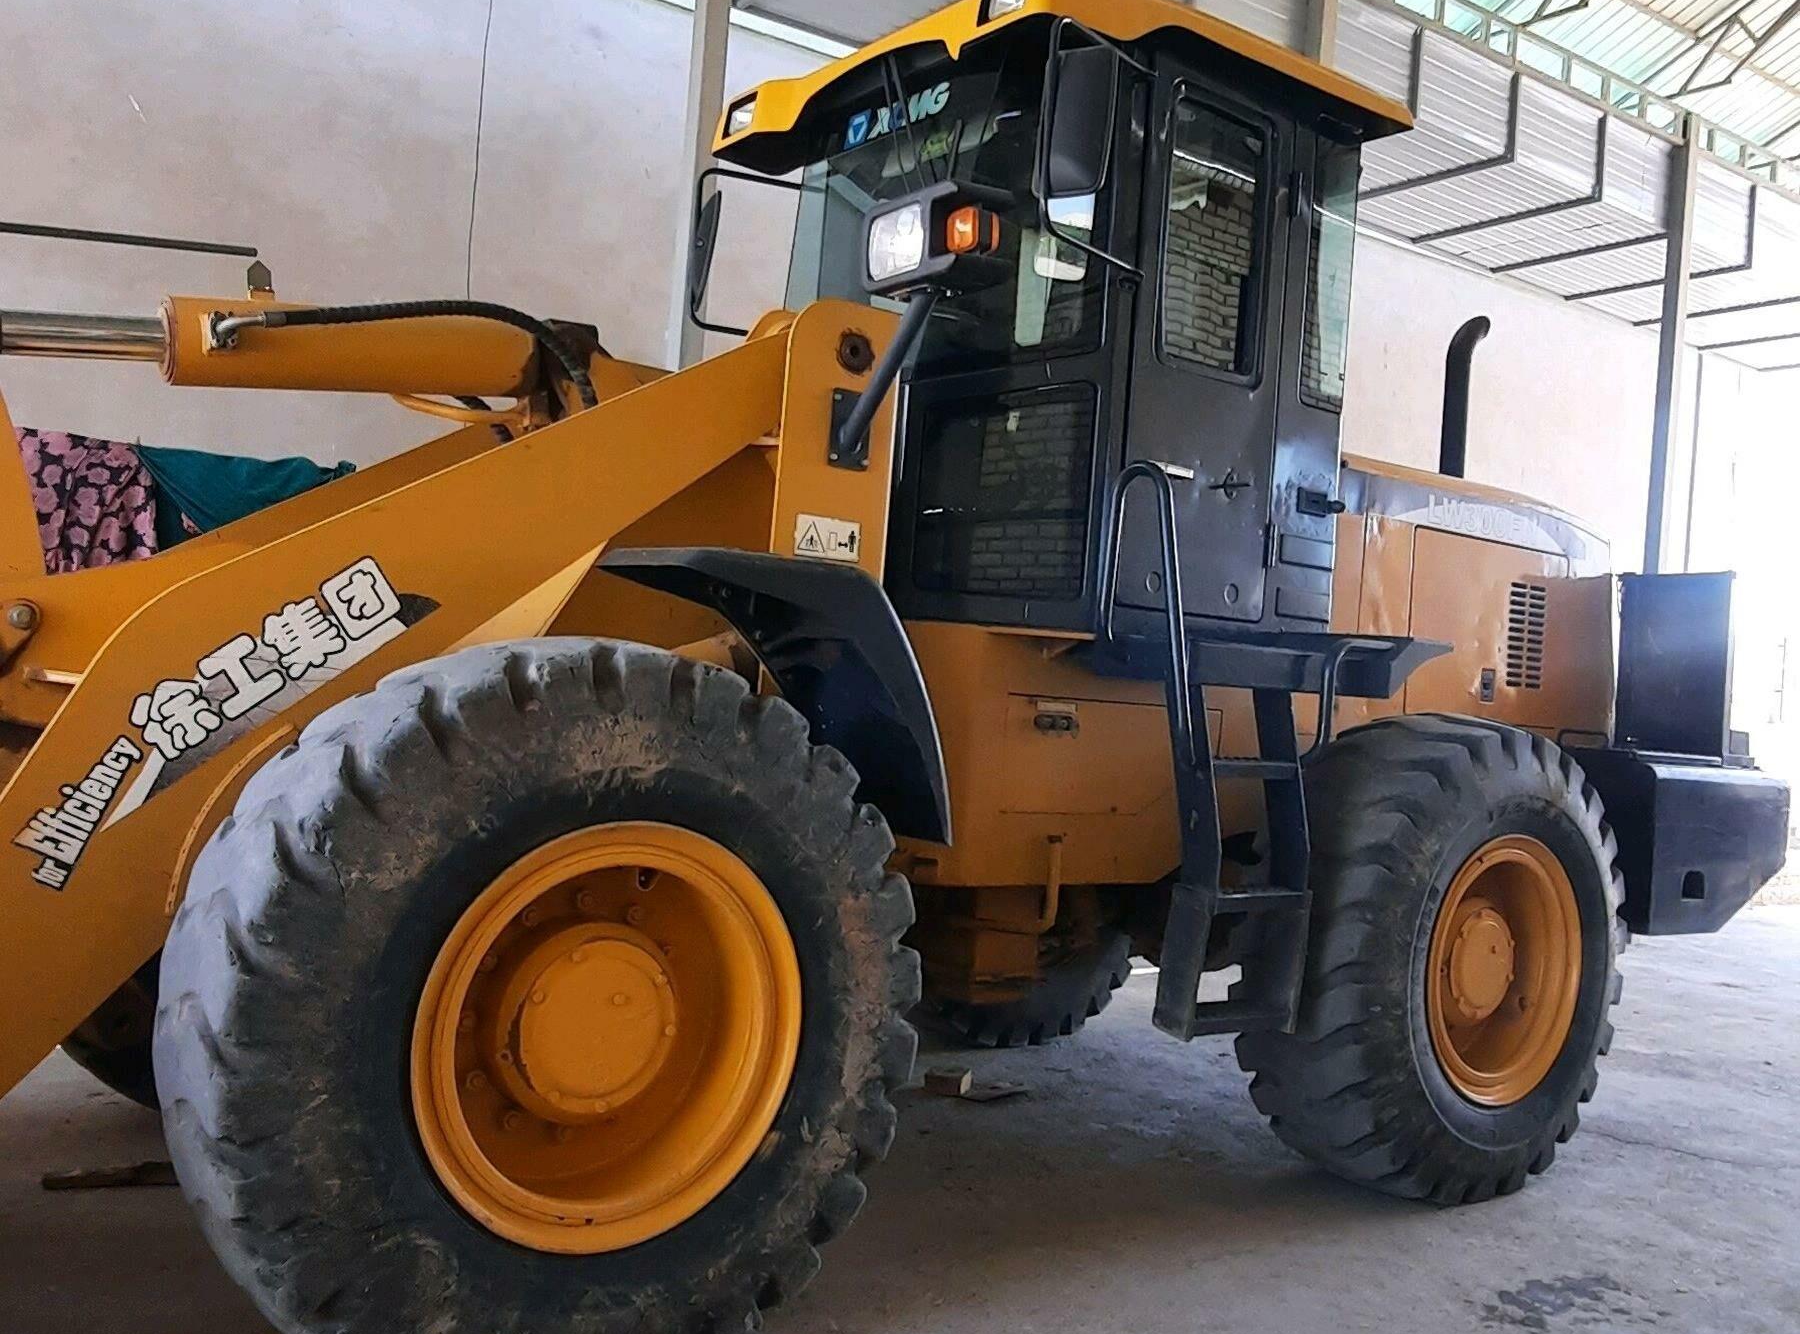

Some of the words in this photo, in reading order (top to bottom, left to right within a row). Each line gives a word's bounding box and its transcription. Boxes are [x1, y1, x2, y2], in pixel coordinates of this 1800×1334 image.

[867, 81, 951, 140] XCMG
[129, 556, 401, 760] 徐工集团
[12, 735, 143, 866] Efficiency
[31, 856, 69, 890] for
